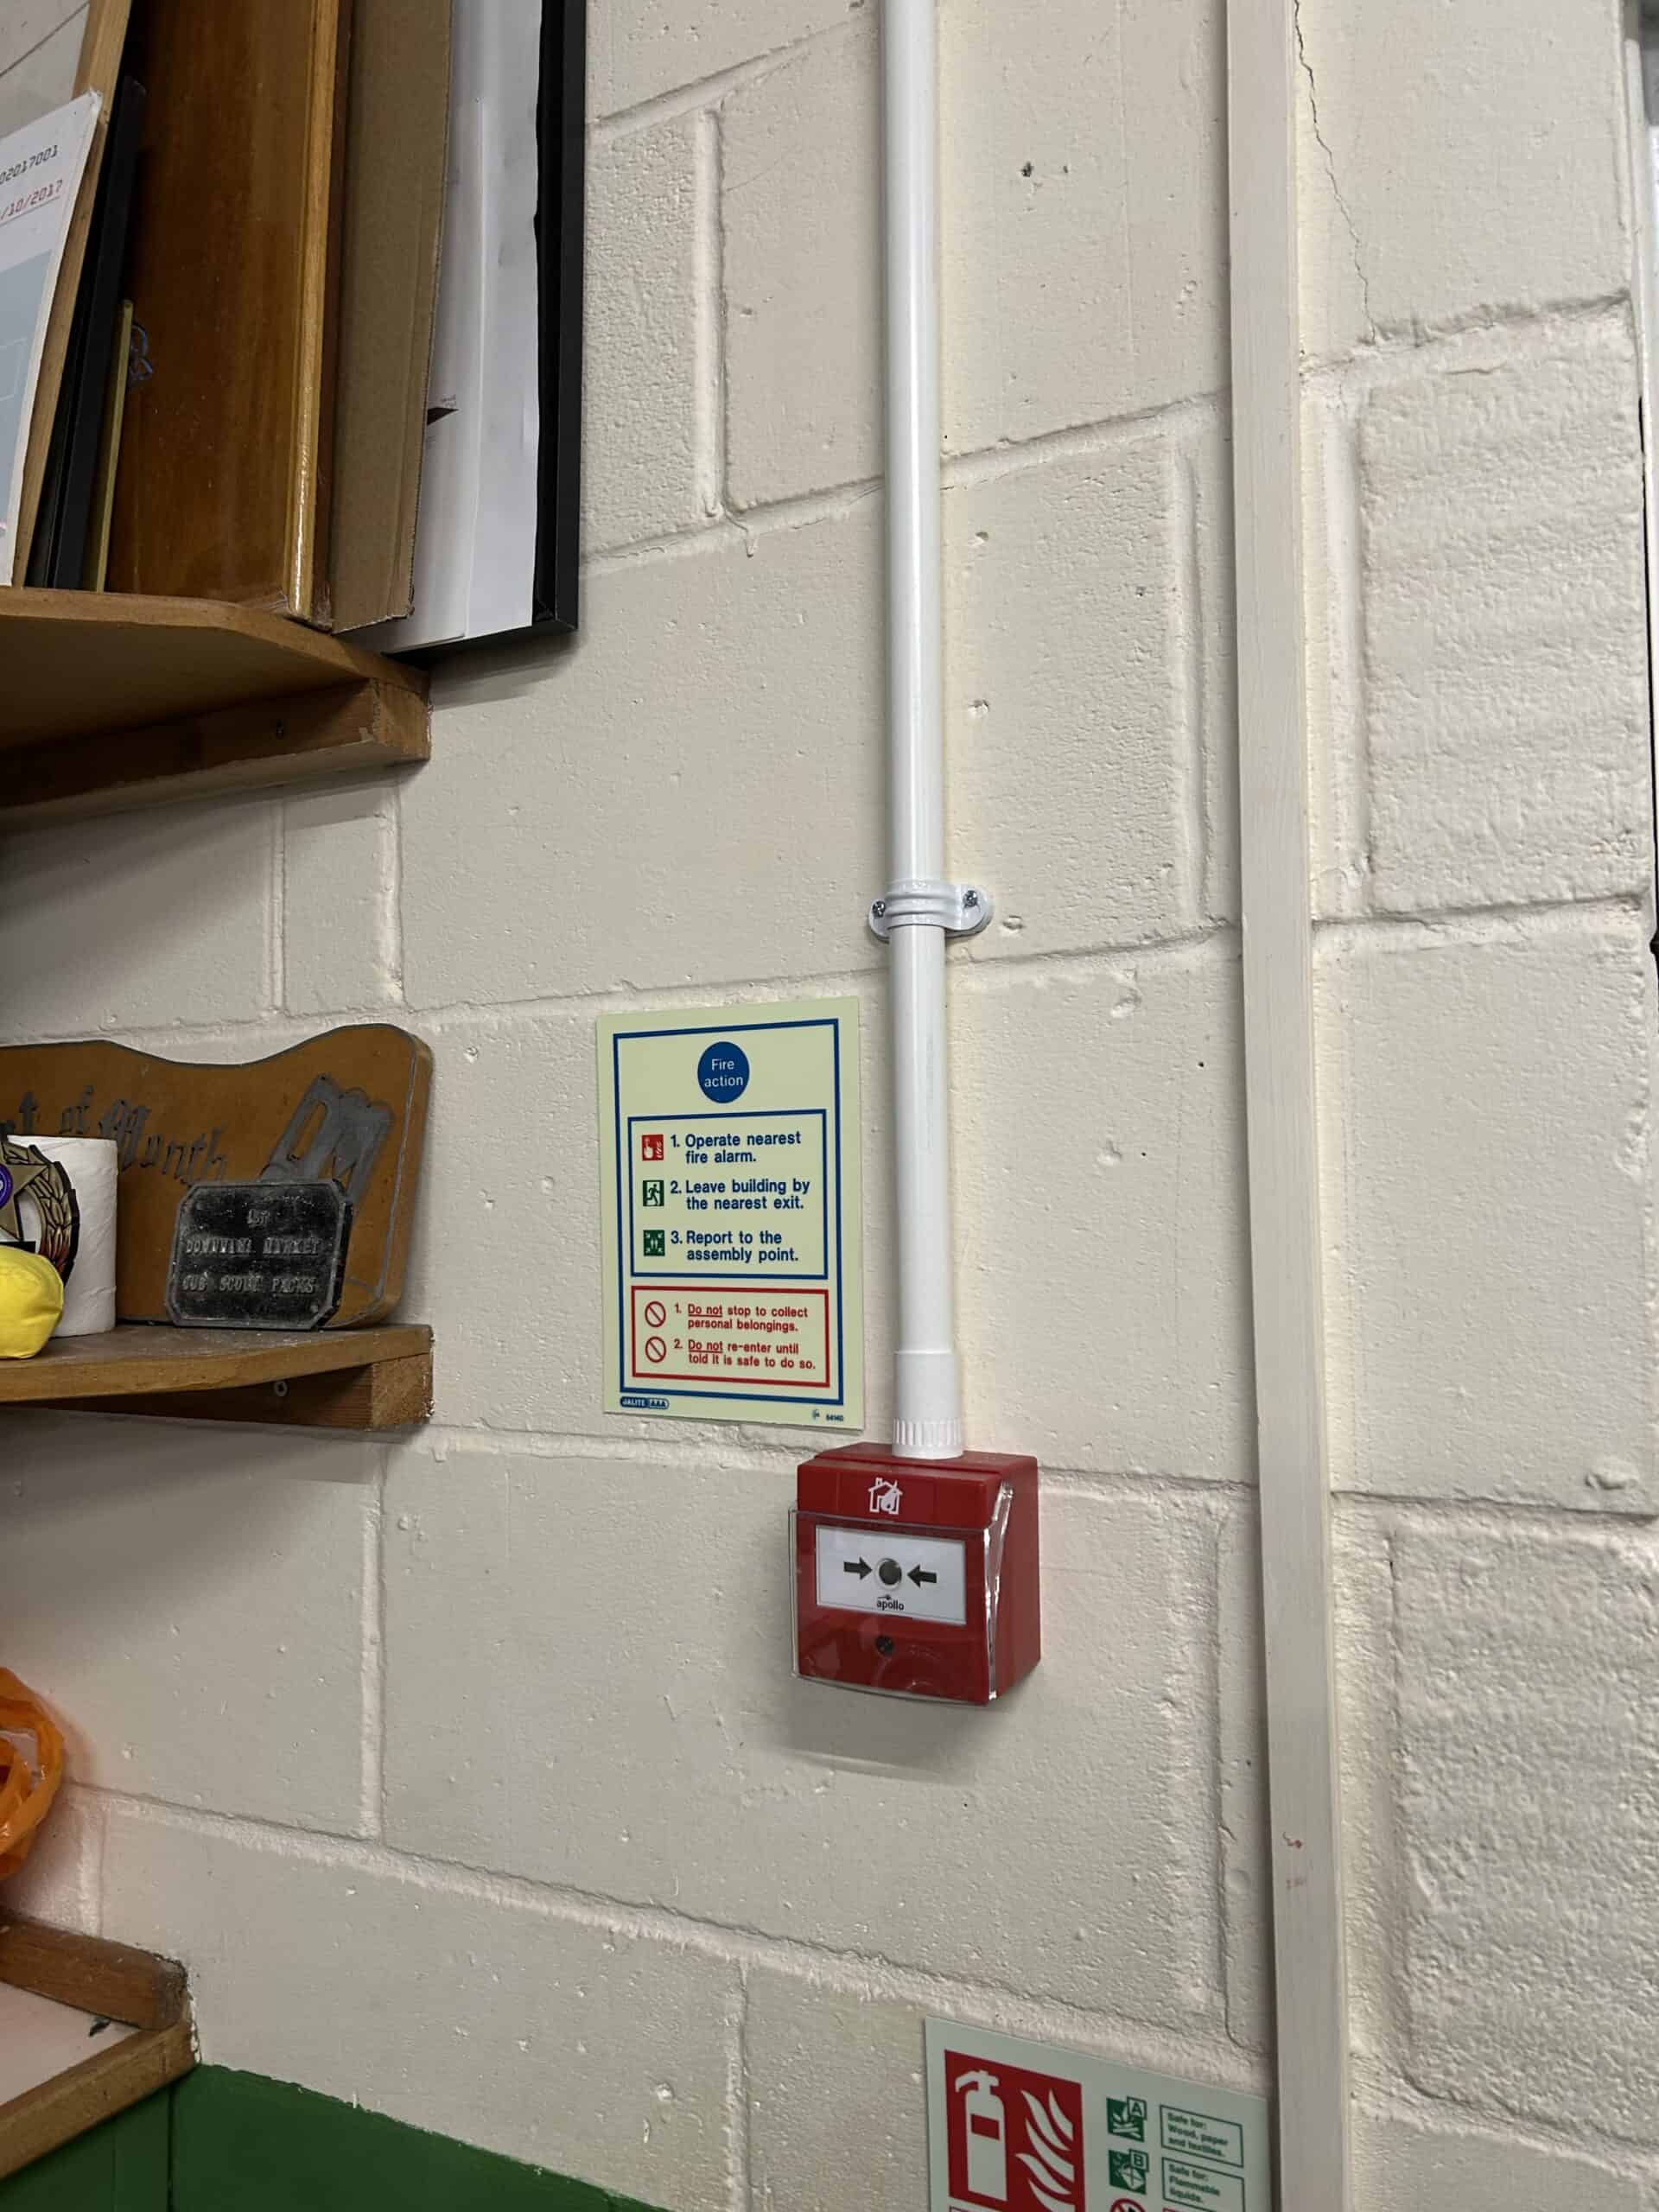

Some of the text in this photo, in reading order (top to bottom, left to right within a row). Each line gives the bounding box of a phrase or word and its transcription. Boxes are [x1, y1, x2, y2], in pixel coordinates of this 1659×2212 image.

[711, 1058, 735, 1071] Fire
[704, 1075, 744, 1088] action
[671, 1130, 802, 1149] 1. Operate nearest
[685, 1149, 757, 1164] fire alarm.
[670, 1178, 810, 1195] 2. Leave building by
[686, 1195, 804, 1211] the nearest exit.
[671, 1230, 782, 1247] 3. Report to the
[686, 1247, 799, 1264] assembly point.
[674, 1303, 808, 1318] 1. Do not stop to collect
[688, 1319, 798, 1333] personal belongings.
[674, 1338, 799, 1355] 2. Do not re-enter until
[689, 1353, 817, 1370] told it is safe to do so.
[876, 1599, 905, 1611] apollo
[1132, 2101, 1142, 2116] A
[1169, 2125, 1228, 2145] Wood, paper
[1134, 2154, 1144, 2167] B
